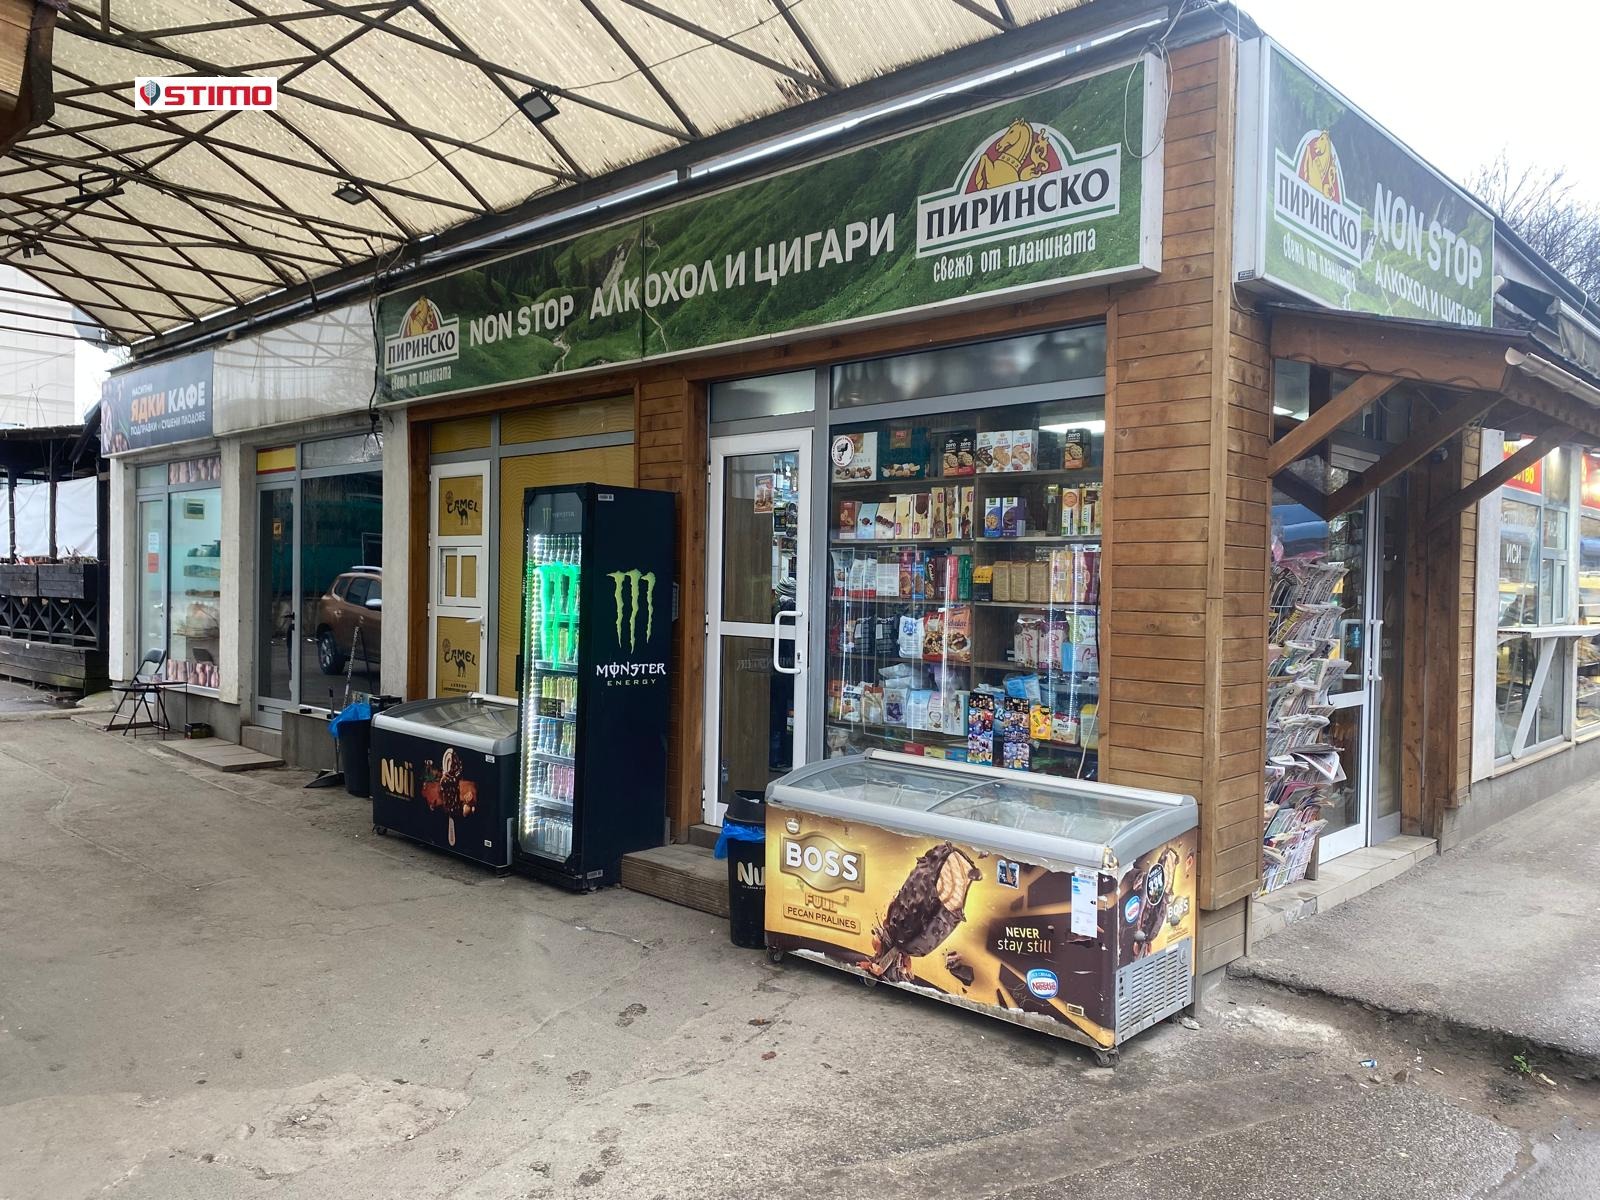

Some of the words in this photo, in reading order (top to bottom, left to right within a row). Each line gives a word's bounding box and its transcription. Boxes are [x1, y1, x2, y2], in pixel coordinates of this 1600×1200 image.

[926, 168, 1110, 240] ПИРИНСКО
[1279, 172, 1358, 250] ПИРИНСКО
[1374, 183, 1424, 261] NON
[1428, 220, 1482, 289] STOP
[589, 259, 718, 320] АЛКОХОЛ
[725, 251, 746, 289] И
[754, 212, 895, 286] ЦИГАРИ
[933, 252, 973, 283] свежо
[981, 249, 1001, 272] от
[1008, 228, 1096, 267] планината
[1375, 260, 1430, 315] АЛКОХОЛ
[1431, 292, 1439, 316] И
[470, 310, 512, 347] NON
[517, 294, 574, 336] STOP
[388, 330, 456, 364] ПИРИНСКО
[131, 392, 165, 424] ЯДКИ
[168, 381, 205, 413] КАФЕ
[447, 498, 479, 514] CAMEL
[444, 650, 477, 666] CAMEL
[596, 661, 666, 678] MONSTER
[607, 678, 657, 687] ENERGY
[381, 758, 415, 799] Nuii
[737, 861, 765, 886] Nu
[786, 841, 858, 881] BOSS
[787, 906, 814, 920] PECAN
[816, 912, 857, 929] PRALINES
[1168, 899, 1188, 918] BOSS
[997, 939, 1023, 954] stay
[1027, 939, 1052, 953] still
[1006, 926, 1040, 939] NEVER
